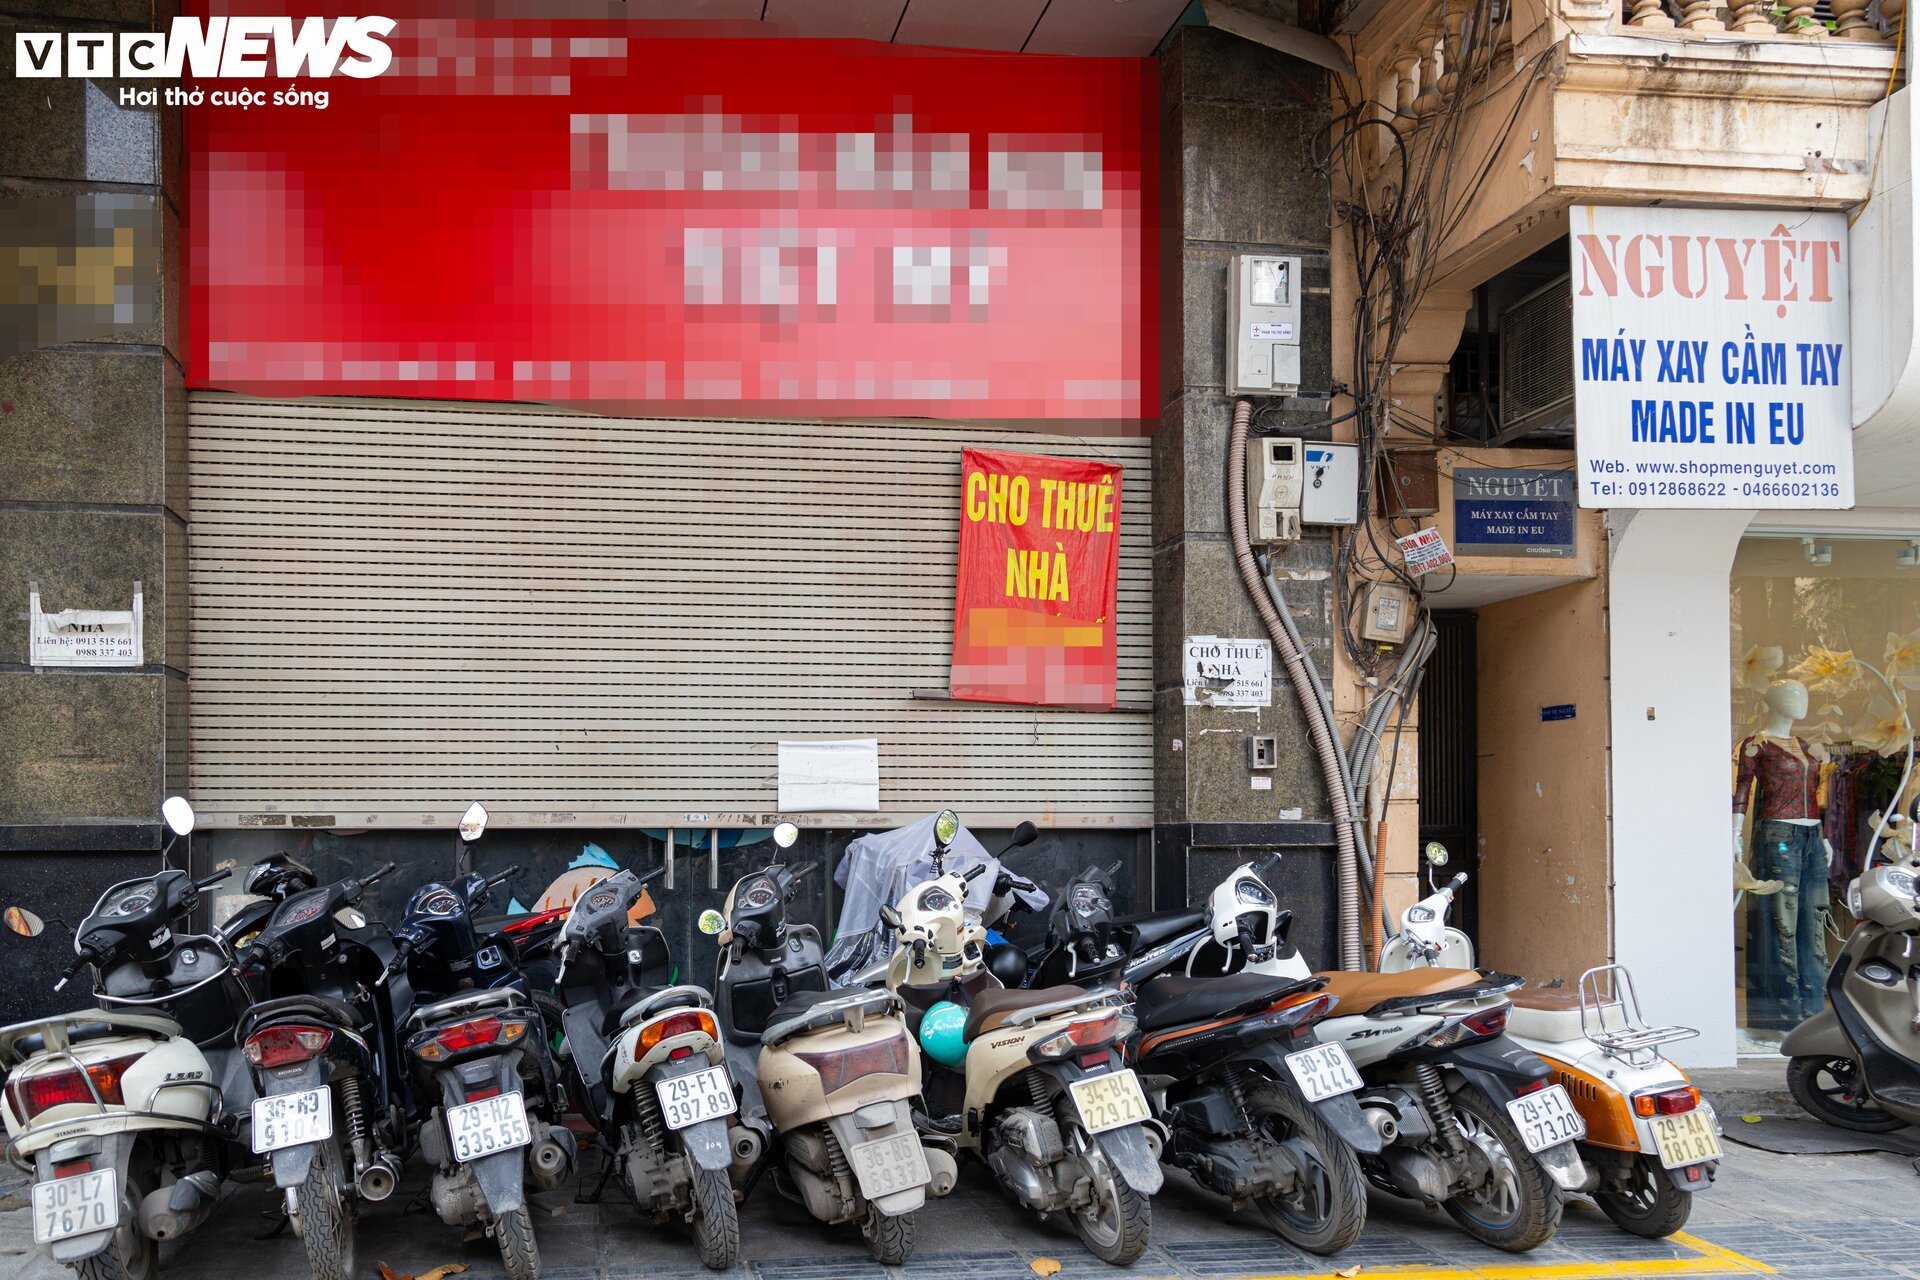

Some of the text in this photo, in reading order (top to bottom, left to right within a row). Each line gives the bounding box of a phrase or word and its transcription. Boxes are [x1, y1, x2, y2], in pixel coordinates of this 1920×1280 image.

[1577, 223, 1841, 319] NGUYỆT
[1582, 323, 1843, 386] MÁY XAY CẦM TAY
[1631, 399, 1804, 445] MADE IN EU
[1636, 460, 1836, 478] www.shopmenguyet.com
[1468, 473, 1563, 501] NGUYỆT
[1590, 481, 1622, 495] Tel:
[1628, 482, 1726, 496] 0912868622
[966, 471, 1115, 533] CHO THUÊ
[1471, 508, 1493, 519] MÁY
[1494, 511, 1513, 519] XAY
[1540, 512, 1559, 520] TAY
[1486, 526, 1545, 535] MADE IN EU
[1005, 542, 1069, 602] NHÀ
[37, 637, 132, 647] Liên hệ: 0913 515 661
[75, 649, 133, 657] 0988 337 403
[1225, 645, 1263, 659] THUÊ
[1251, 680, 1263, 688] 661
[991, 1035, 1025, 1049] VISION
[1295, 1047, 1342, 1075] 30-X6
[163, 1070, 203, 1082] LEAD
[668, 1071, 718, 1101] 29-F1
[1082, 1075, 1130, 1104] 34-B4
[1307, 1067, 1354, 1097] 2444
[459, 1097, 513, 1132] 29-H2
[669, 1091, 731, 1124] 397.89
[1085, 1096, 1145, 1129] 229.21
[1518, 1091, 1563, 1123] 29-F1
[458, 1120, 525, 1157] 335.55
[1525, 1112, 1579, 1147] 673.20
[1657, 1113, 1705, 1141] 29-AA
[1664, 1134, 1716, 1163] 181.81
[45, 1175, 103, 1210] 30-L7
[46, 1202, 106, 1237] 7670
